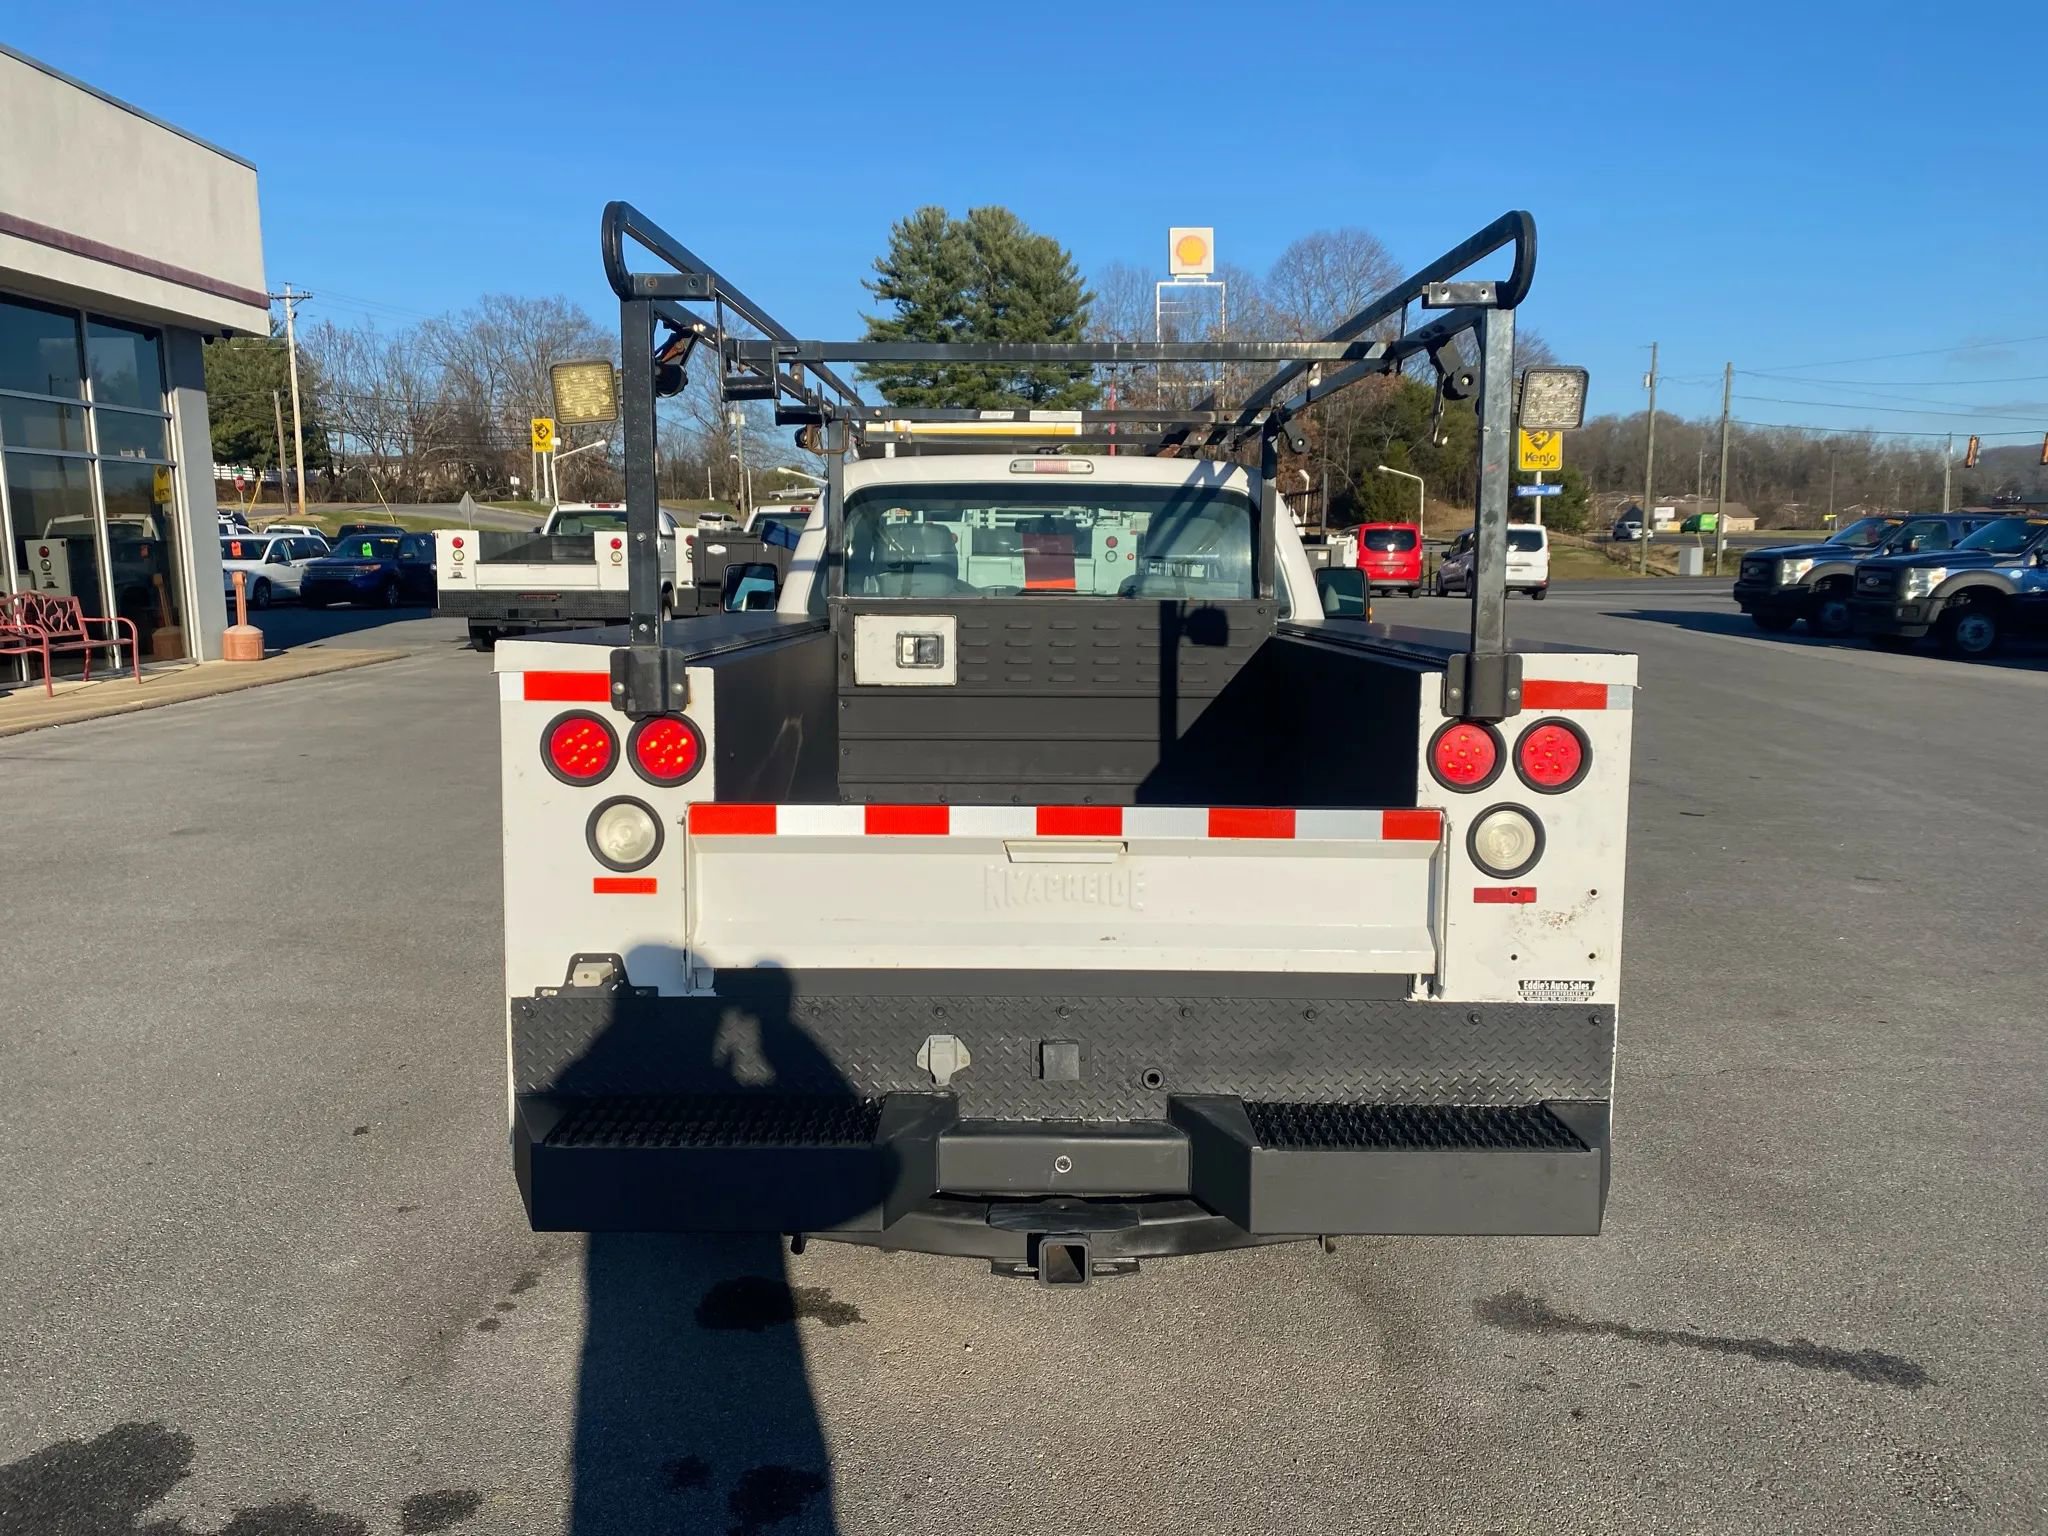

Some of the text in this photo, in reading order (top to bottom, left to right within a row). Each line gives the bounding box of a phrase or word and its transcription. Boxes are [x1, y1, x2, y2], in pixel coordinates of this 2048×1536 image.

[1525, 452, 1556, 466] Kenjo
[1523, 980, 1590, 990] Eddie's Auto Sales
